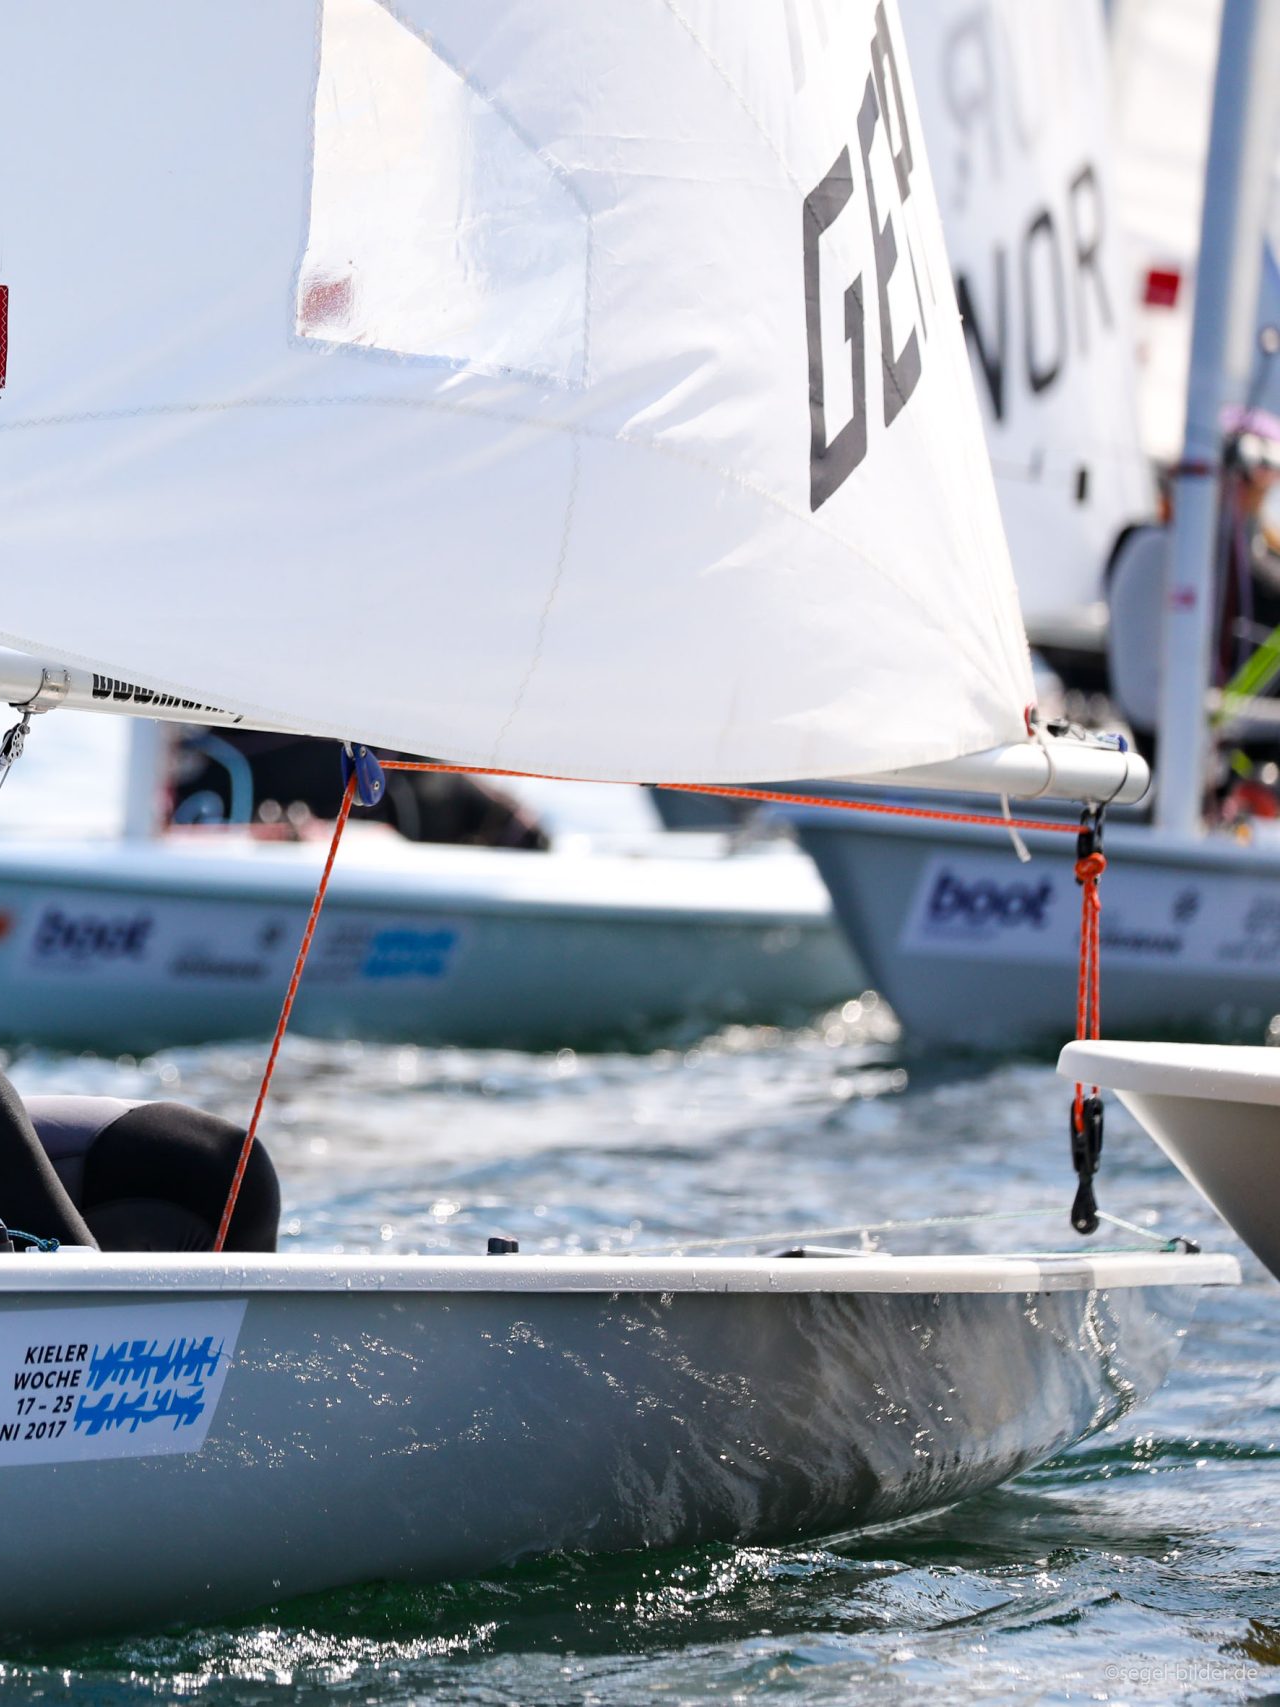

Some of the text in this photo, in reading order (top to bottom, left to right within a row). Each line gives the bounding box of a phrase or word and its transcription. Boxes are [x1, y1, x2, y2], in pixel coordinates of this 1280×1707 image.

[24, 1343, 88, 1365] KIELER
[13, 1369, 82, 1391] WOCHE
[17, 1397, 36, 1415] 17
[52, 1394, 75, 1414] 25
[23, 1420, 67, 1441] 2017
